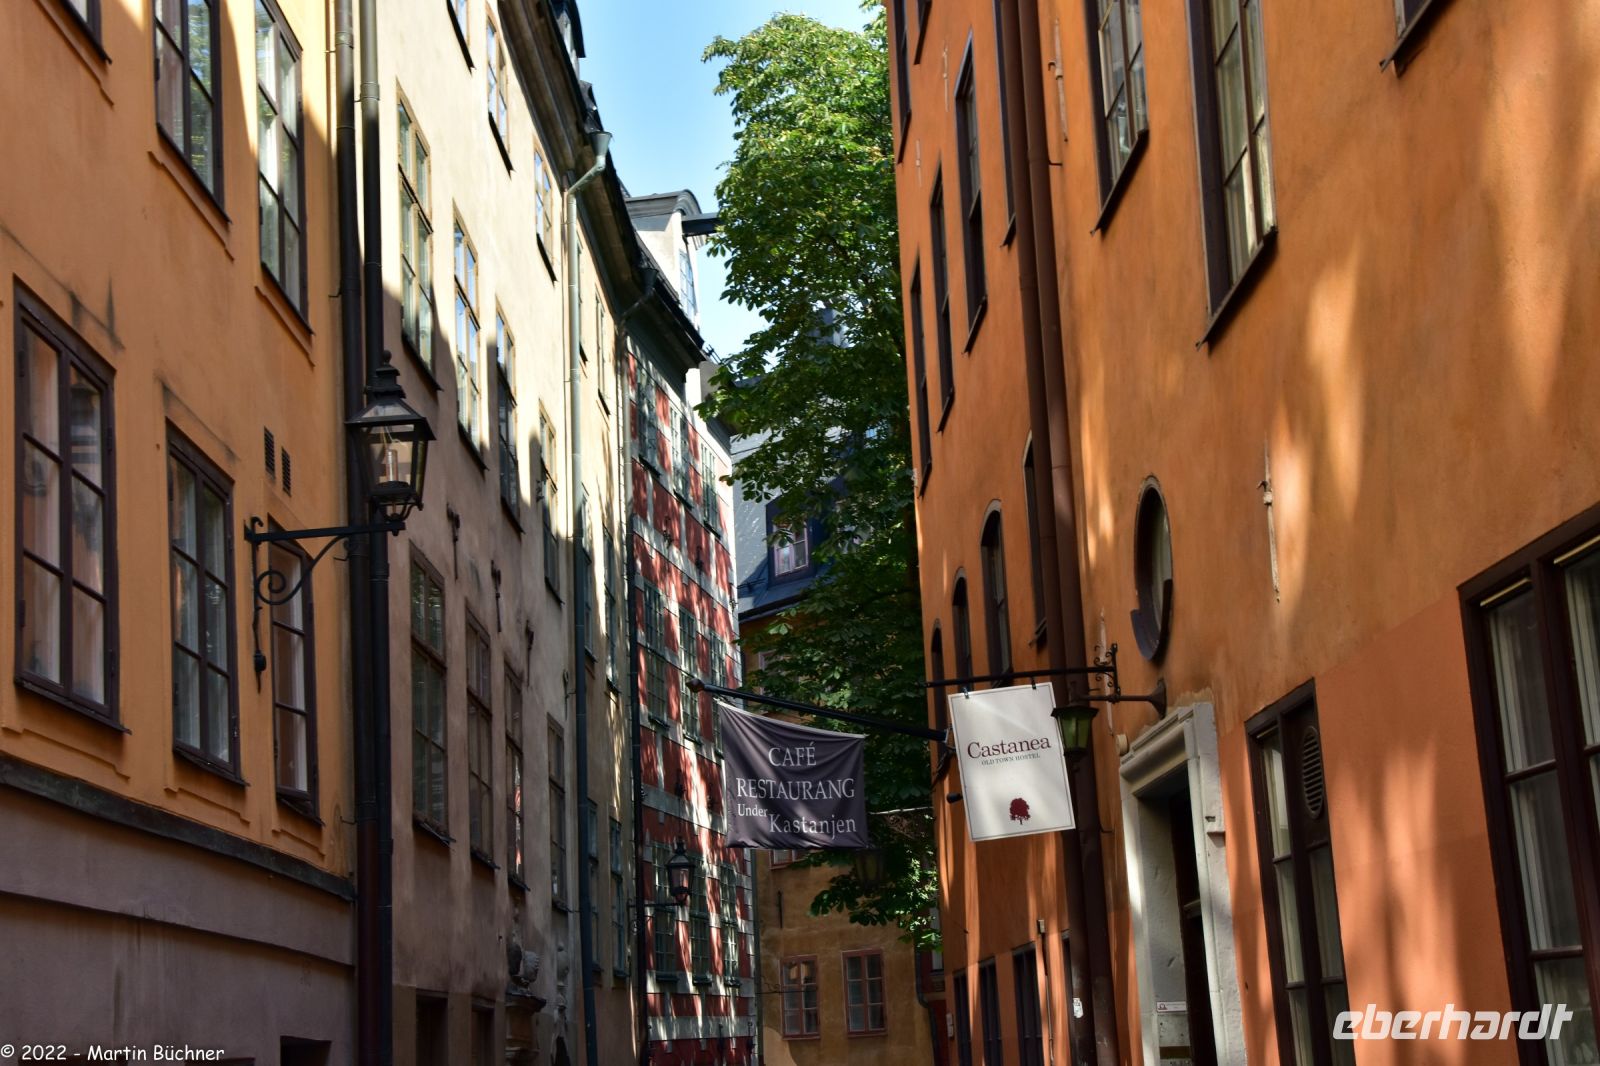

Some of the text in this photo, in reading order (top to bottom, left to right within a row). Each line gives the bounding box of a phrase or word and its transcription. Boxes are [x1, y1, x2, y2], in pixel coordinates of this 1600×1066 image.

[768, 741, 817, 767] CAFÉ
[967, 737, 1051, 759] Castanea
[981, 752, 1041, 766] OLD TOWN HOSTEL
[736, 777, 855, 800] RESTAURANG
[738, 803, 768, 817] Under
[769, 813, 857, 839] Kastanjen
